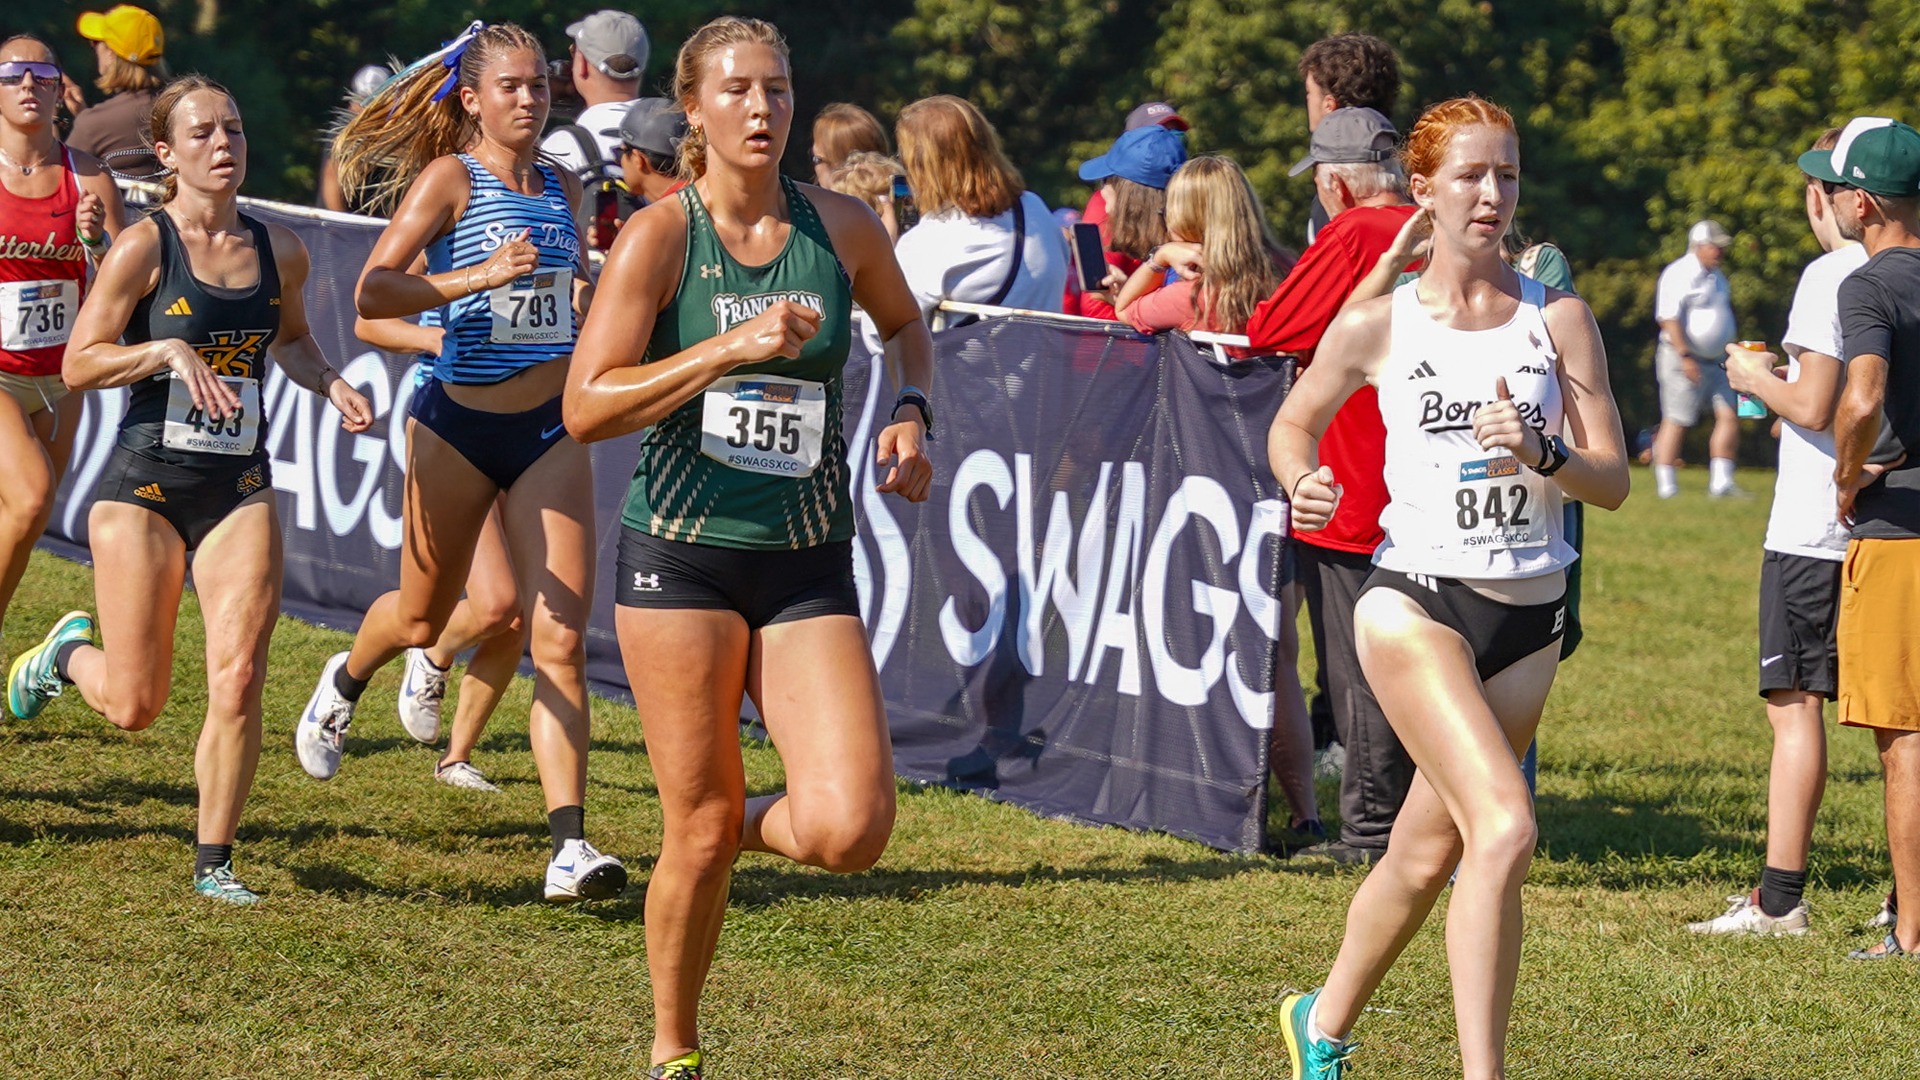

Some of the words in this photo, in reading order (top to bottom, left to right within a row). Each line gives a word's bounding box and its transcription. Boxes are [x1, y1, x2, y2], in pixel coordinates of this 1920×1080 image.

[480, 222, 533, 251] Sa
[18, 302, 65, 335] 736
[509, 294, 558, 328] 793
[714, 293, 823, 335] FRANCAN
[22, 333, 65, 346] #SWAGSXCC
[511, 331, 559, 341] #SWAGSXCC
[1515, 365, 1547, 376] A10
[185, 404, 244, 437] 493
[1419, 390, 1547, 431] Bones
[186, 437, 240, 450] #SWAGSXCC
[726, 406, 802, 455] 355
[727, 455, 798, 471] #SWAGSXCC
[133, 488, 166, 502] adidas
[1455, 484, 1530, 530] 842
[1463, 532, 1529, 546] #SWAGSXCC
